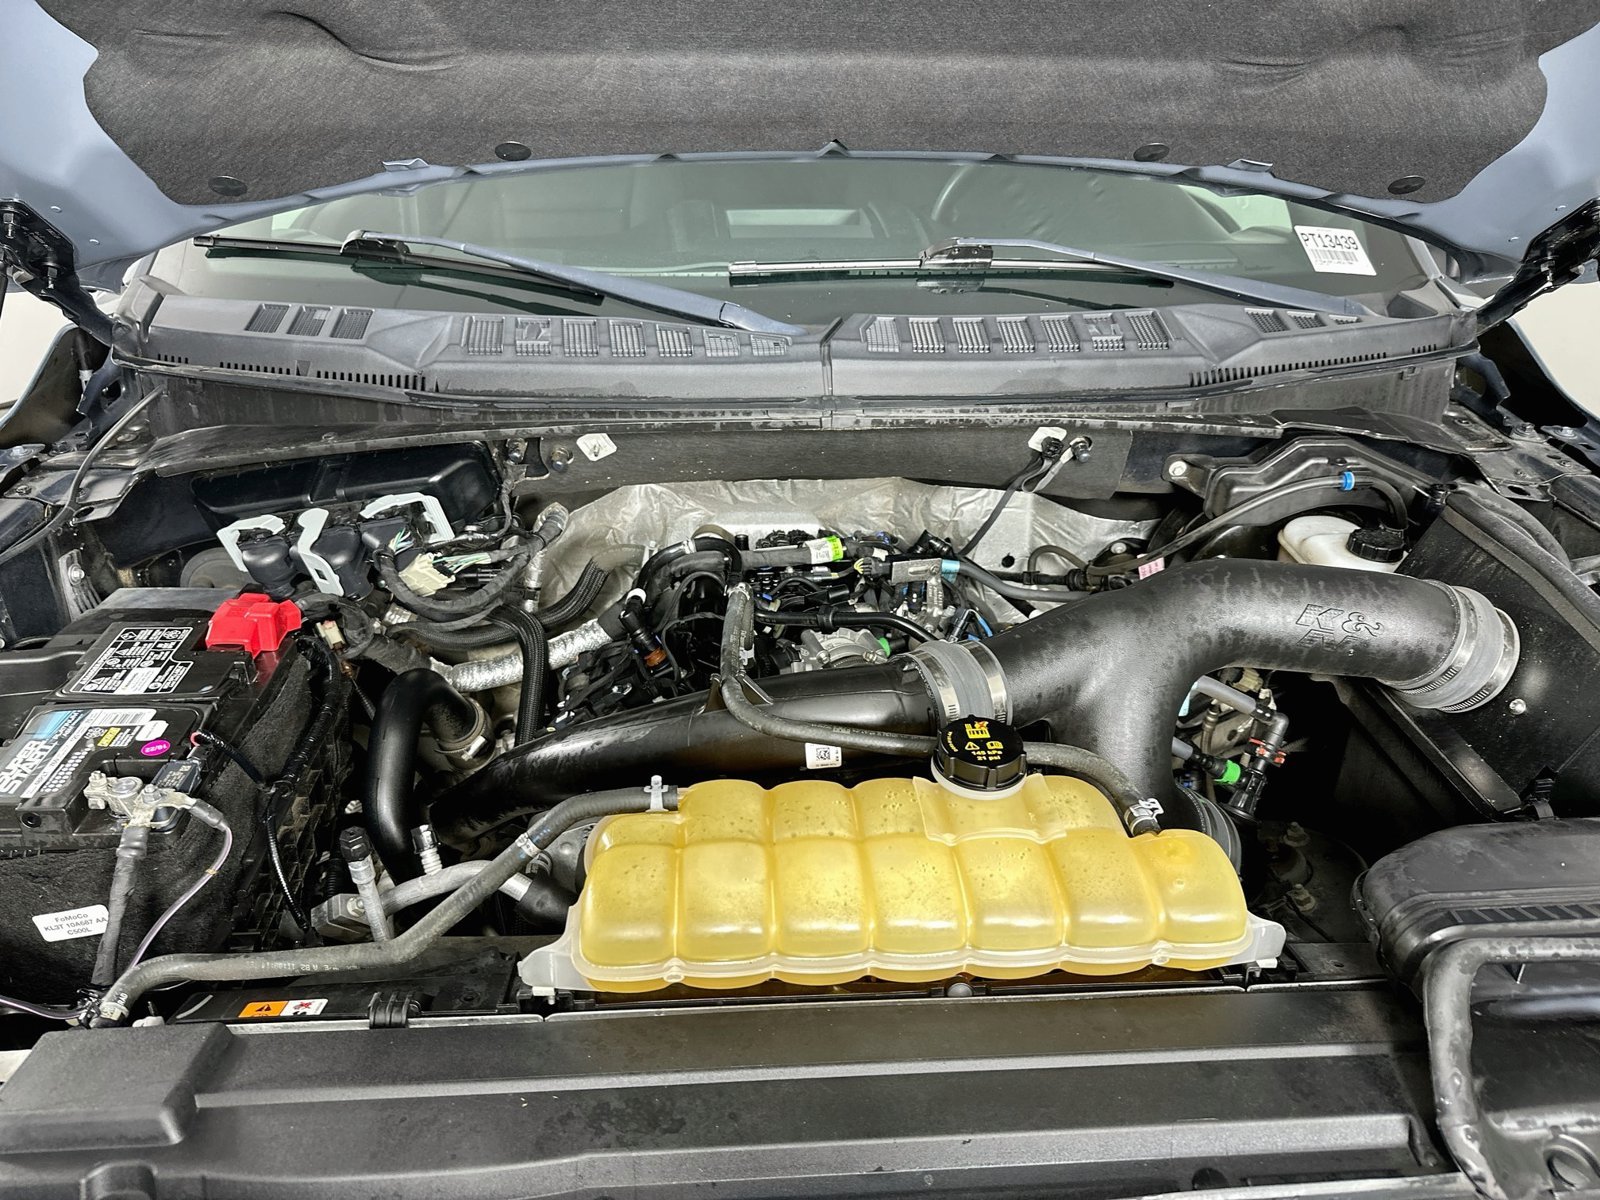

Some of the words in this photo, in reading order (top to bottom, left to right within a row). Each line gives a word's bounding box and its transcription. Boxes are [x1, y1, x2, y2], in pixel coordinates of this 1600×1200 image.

[1300, 232, 1359, 250] PT13439
[0, 740, 44, 793] SUPER
[4, 740, 59, 795] START
[55, 913, 89, 923] FoMoCo
[44, 924, 64, 932] KL3T
